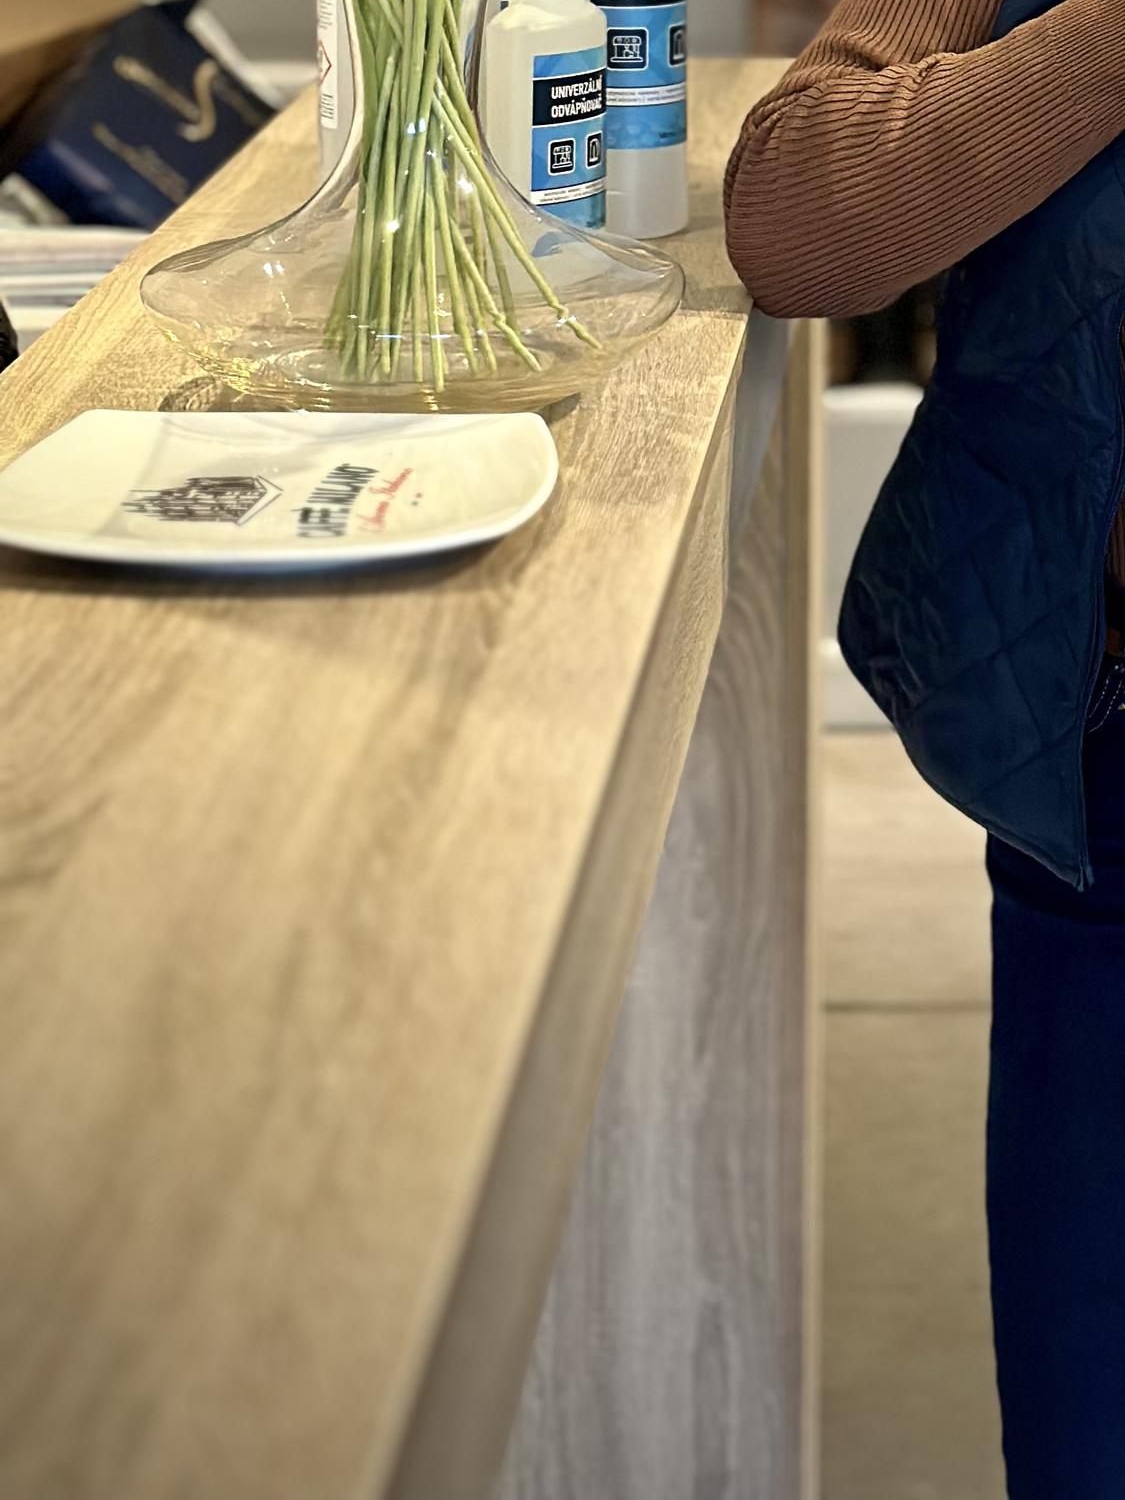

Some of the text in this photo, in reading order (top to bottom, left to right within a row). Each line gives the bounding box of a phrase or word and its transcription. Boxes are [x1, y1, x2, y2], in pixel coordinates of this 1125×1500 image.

[551, 74, 602, 99] UNIVERZÁLNÍ
[551, 93, 602, 118] ODVÁPŇOVAČ
[307, 463, 379, 505] MILANO
